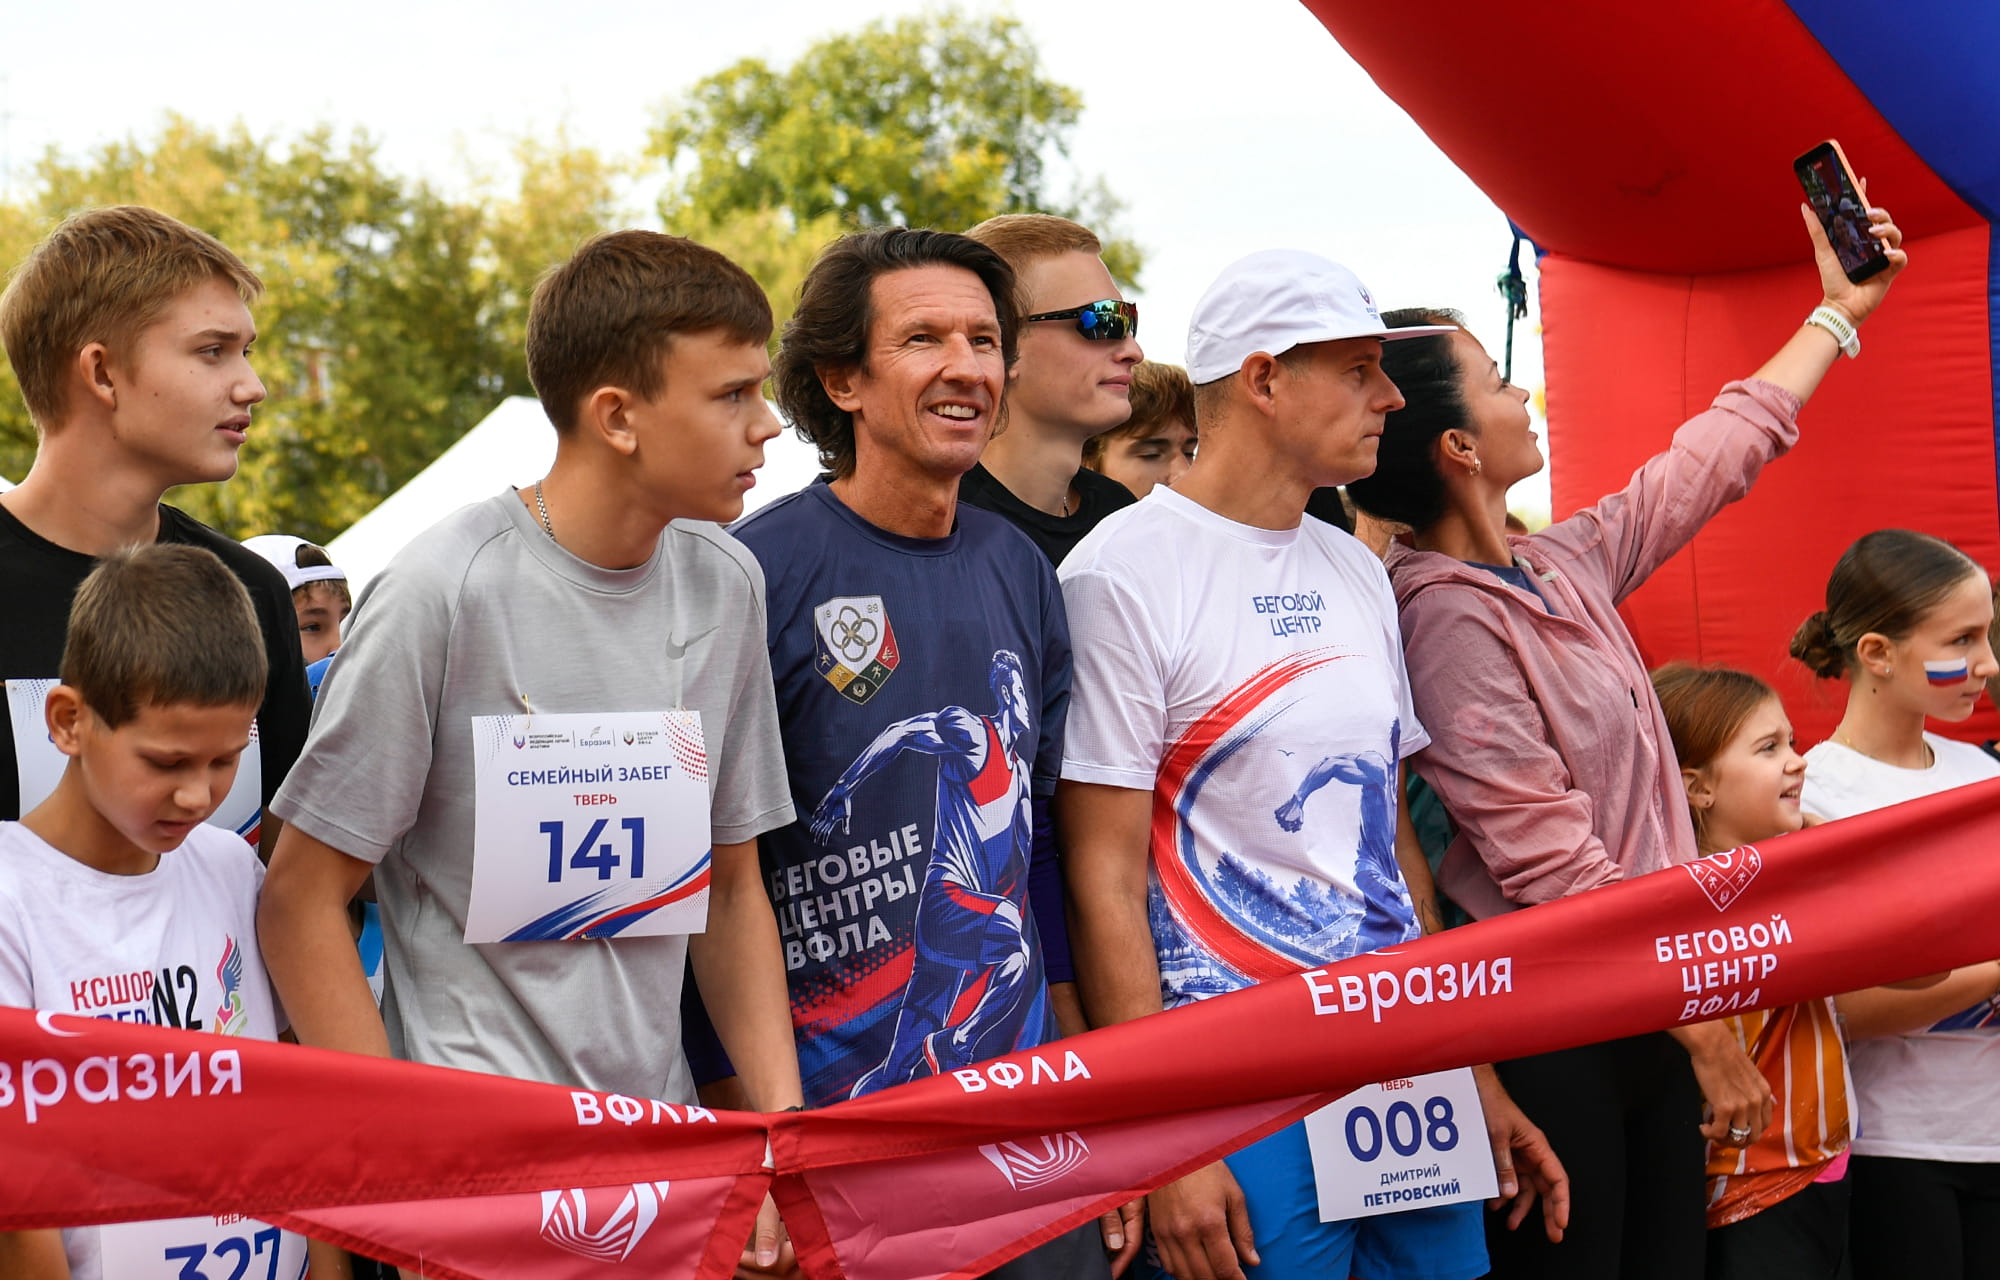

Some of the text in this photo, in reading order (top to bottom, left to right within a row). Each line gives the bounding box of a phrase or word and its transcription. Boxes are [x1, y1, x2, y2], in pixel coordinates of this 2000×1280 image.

[1252, 589, 1326, 614] БЕГОВОЙ
[1270, 615, 1322, 638] ЦЕНТР
[579, 738, 611, 748] Евразия
[507, 764, 672, 786] СЕМЕЙНЫЙ ЗАБЕГ
[573, 793, 617, 806] ТВЕРЬ
[539, 817, 645, 883] 141
[771, 823, 922, 901] БЕГОВЫЕ
[779, 864, 917, 938] ЦЕНТРЫ
[786, 915, 893, 971] ВФЛА
[1655, 914, 1793, 963] БЕГОВОЙ
[70, 970, 154, 1011] КСШОР
[1300, 957, 1512, 1023] Евразия
[1681, 953, 1778, 995] ЦЕНТР
[1678, 988, 1760, 1021] ВФЛА
[952, 1050, 1092, 1093] ВФЛА
[1379, 1079, 1414, 1092] ТВЕРЬ
[570, 1091, 718, 1126] ВФЛА
[1345, 1096, 1459, 1162] 008
[1364, 1178, 1461, 1207] ПЕТРОВСКИЙ
[1380, 1163, 1441, 1186] ДМИТРИЙ
[165, 1226, 281, 1280] 327
